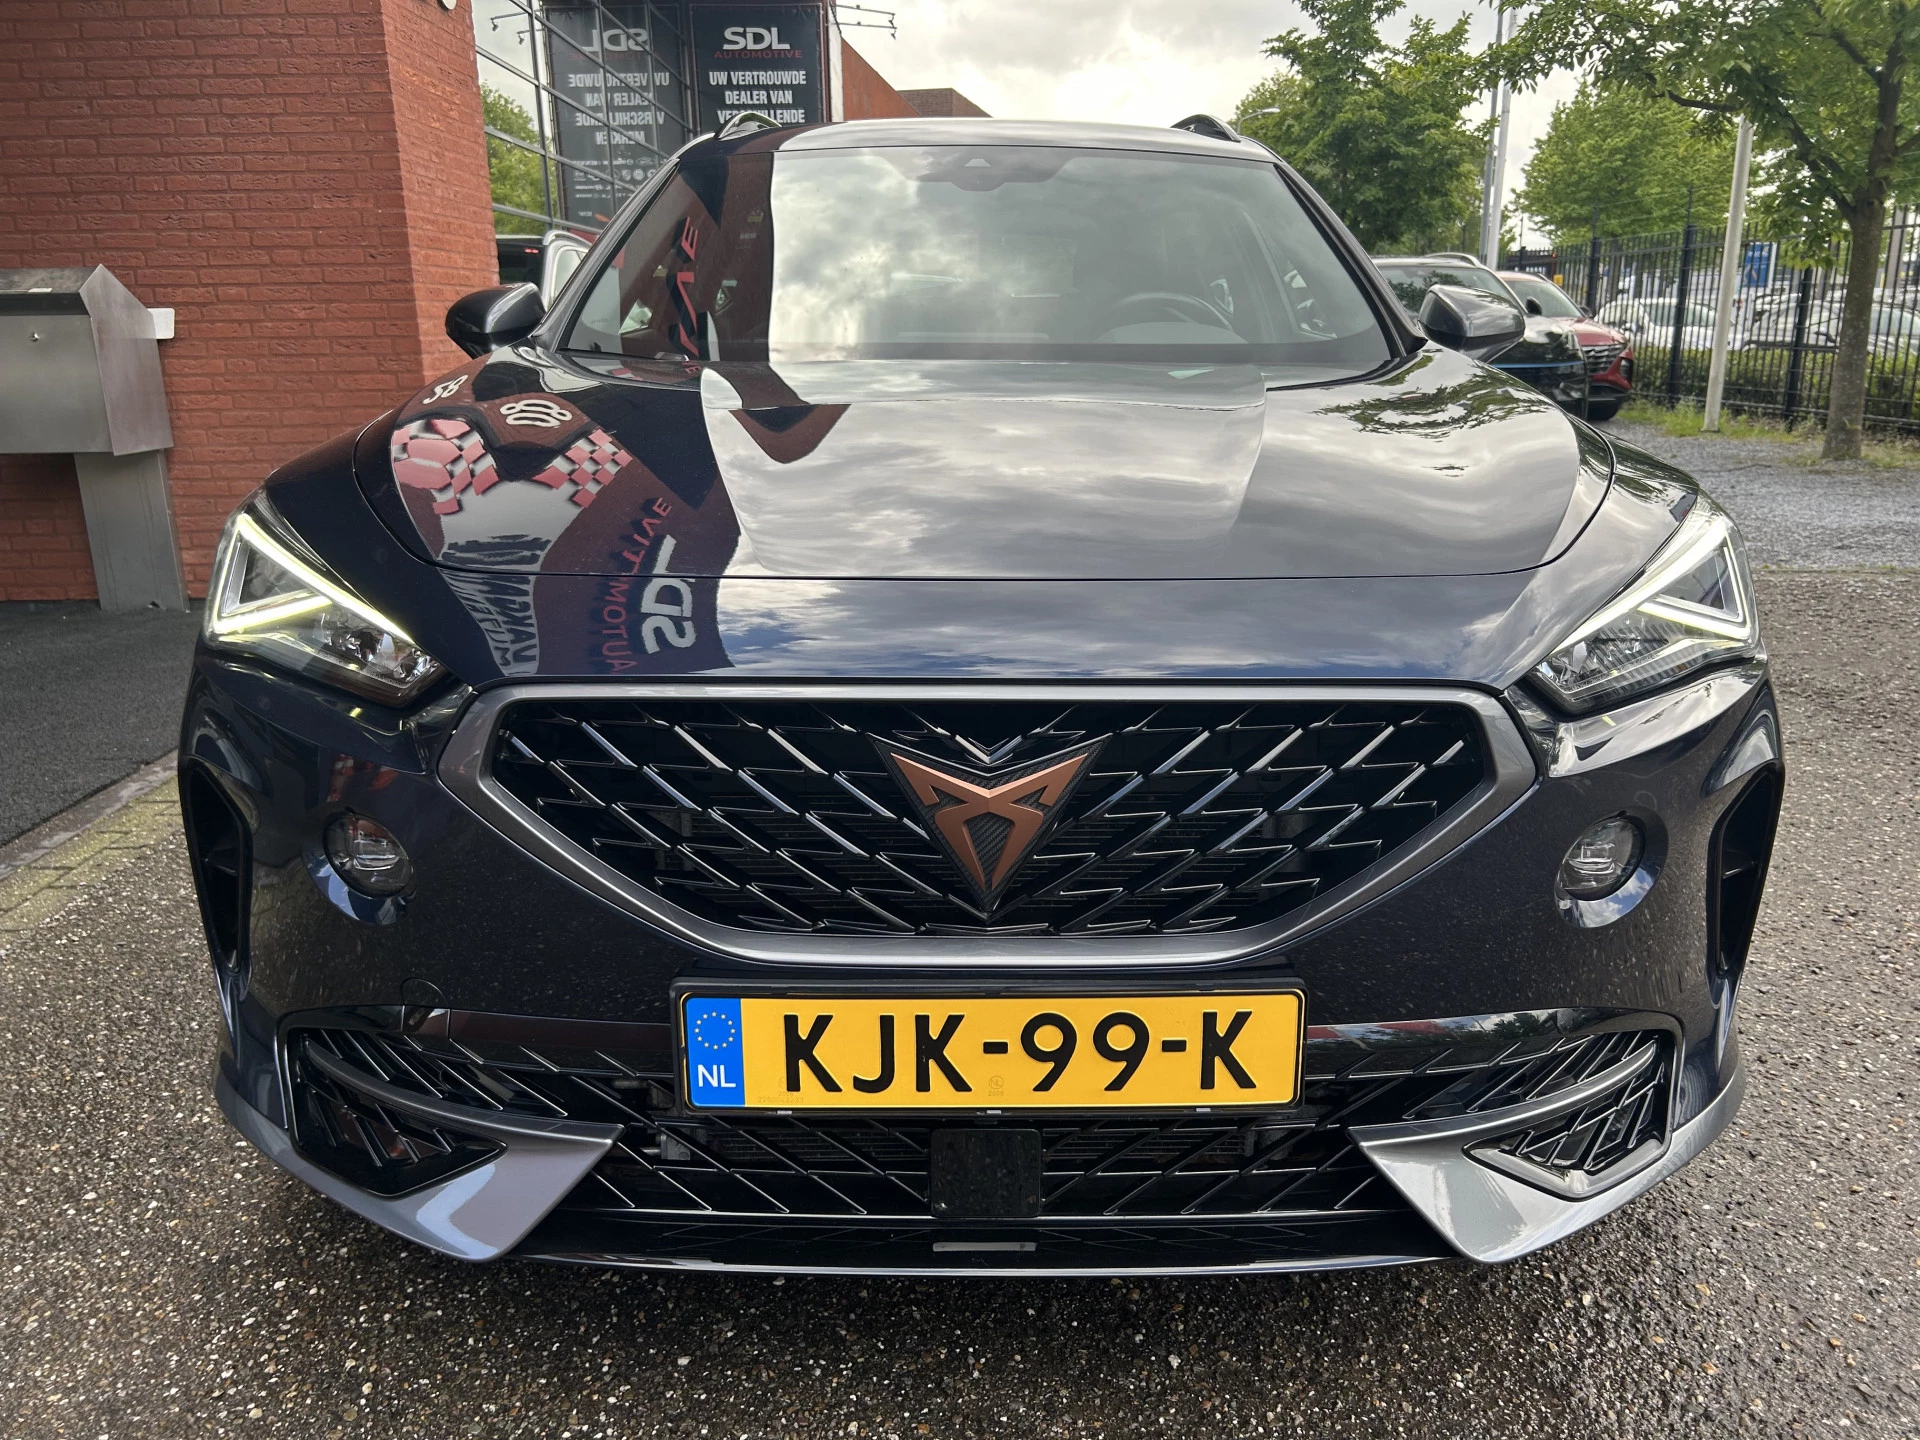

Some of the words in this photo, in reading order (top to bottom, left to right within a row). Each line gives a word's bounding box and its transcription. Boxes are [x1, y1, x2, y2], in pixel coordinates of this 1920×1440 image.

[723, 27, 790, 50] SDL
[714, 50, 802, 59] AUTOMOTIVE
[709, 71, 728, 85] UW
[730, 71, 806, 85] VERTROUWDE
[725, 90, 767, 104] DEALER
[770, 90, 793, 104] VAN
[782, 1010, 1258, 1094] KJK-99-K
[697, 1064, 736, 1088] NL
